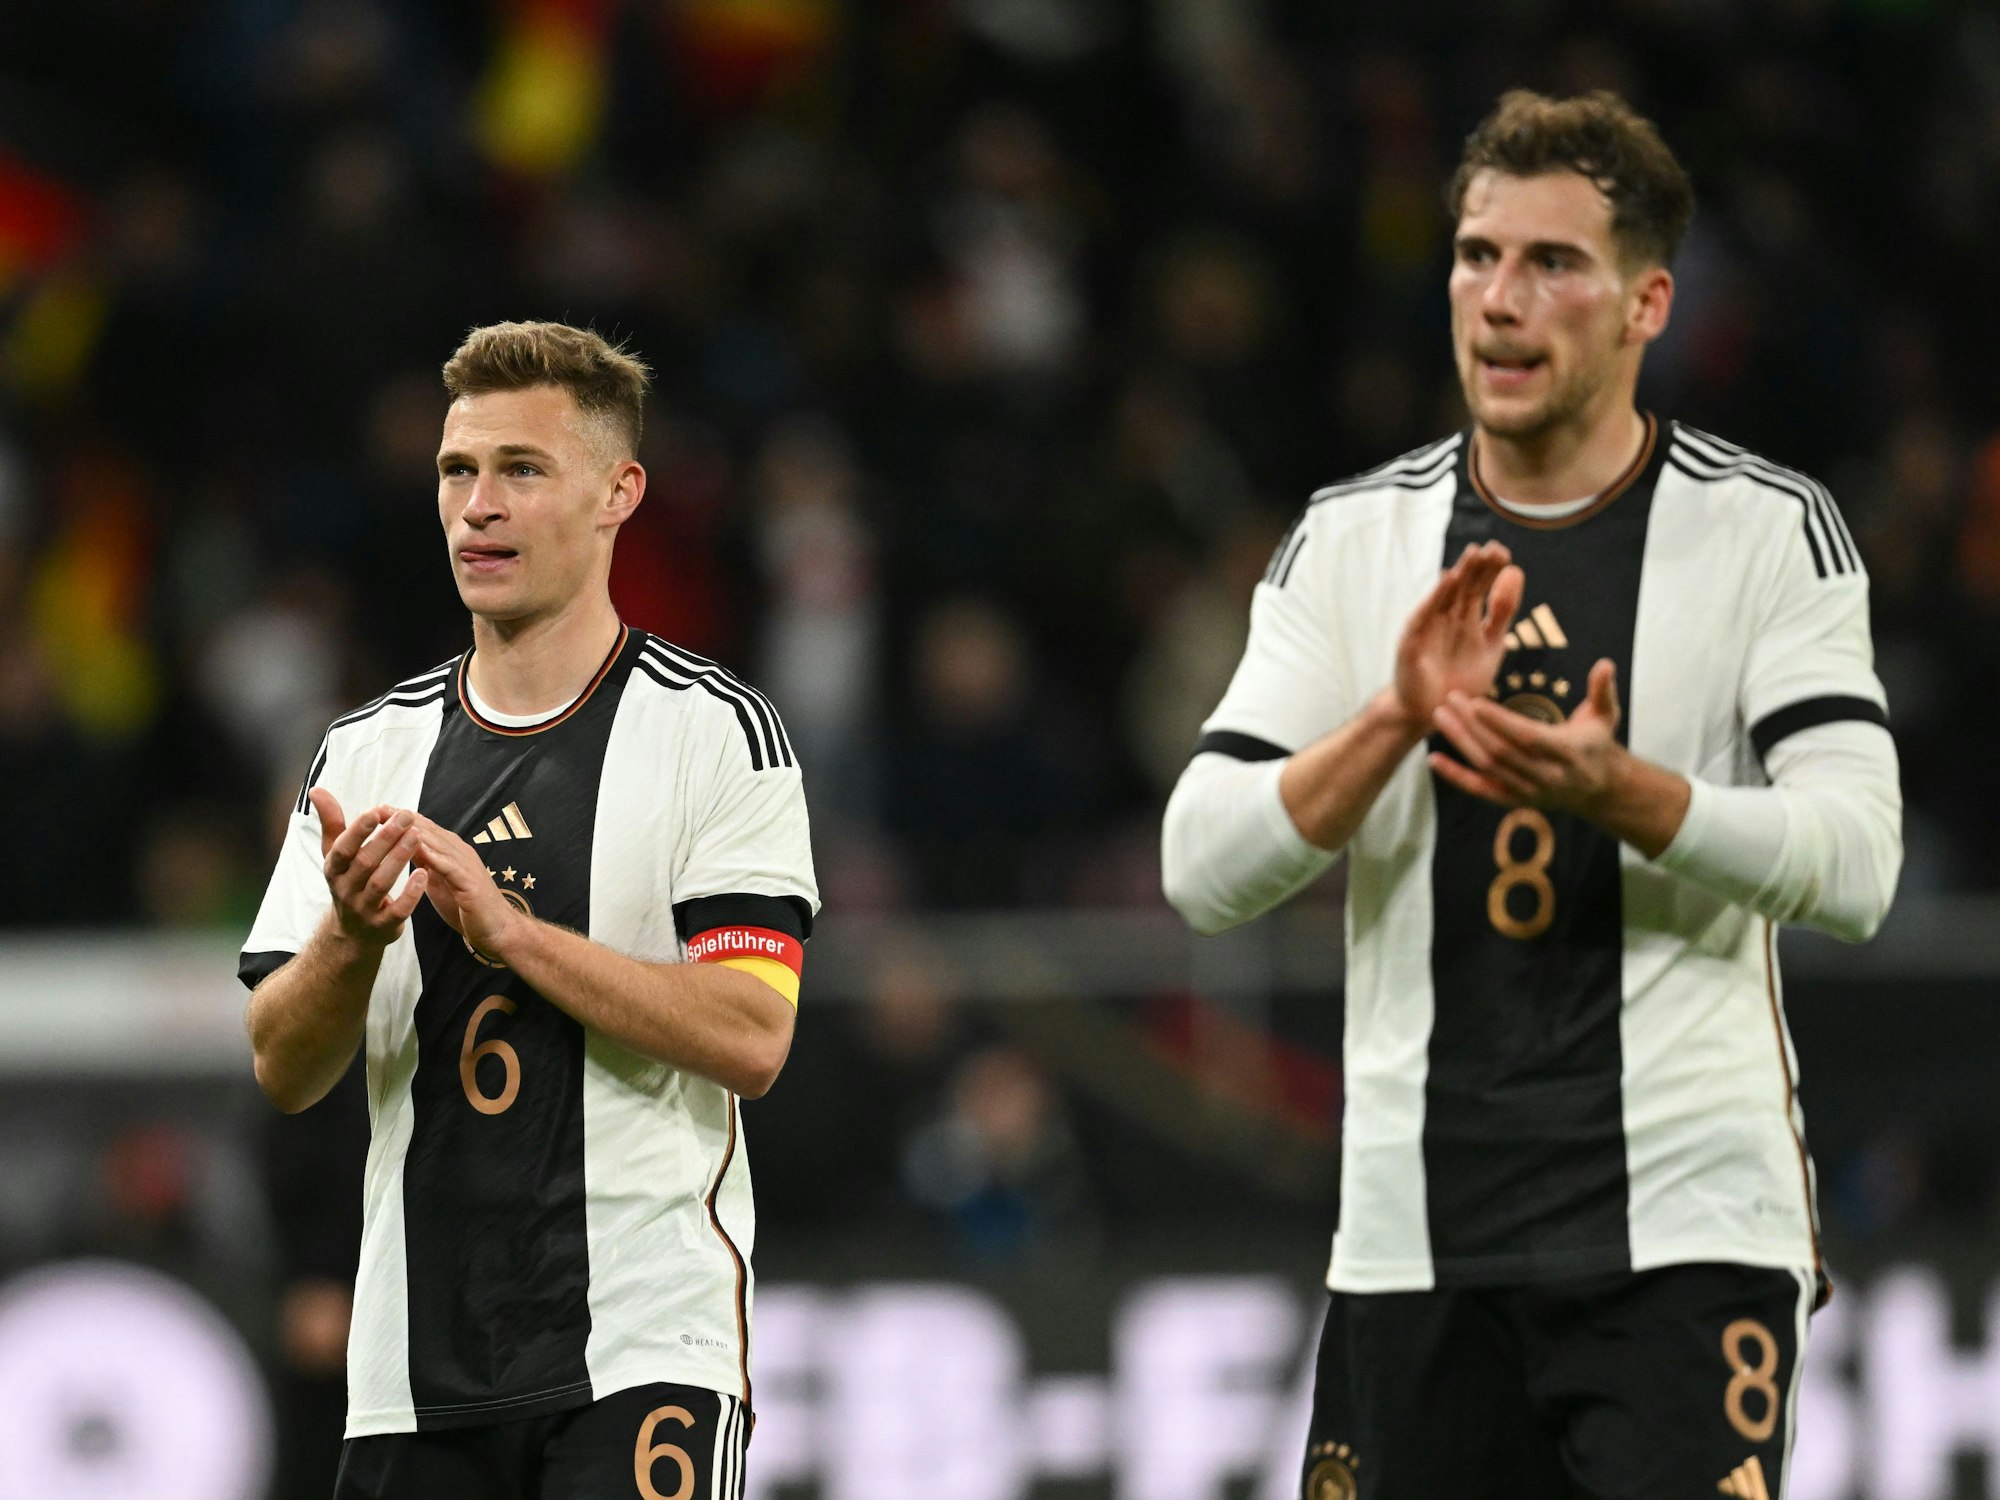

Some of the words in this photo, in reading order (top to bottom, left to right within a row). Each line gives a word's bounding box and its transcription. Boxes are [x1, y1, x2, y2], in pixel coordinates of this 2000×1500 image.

[1487, 807, 1555, 939] 8
[459, 994, 521, 1115] 6
[1722, 1319, 1779, 1442] 8
[634, 1405, 696, 1500] 6
